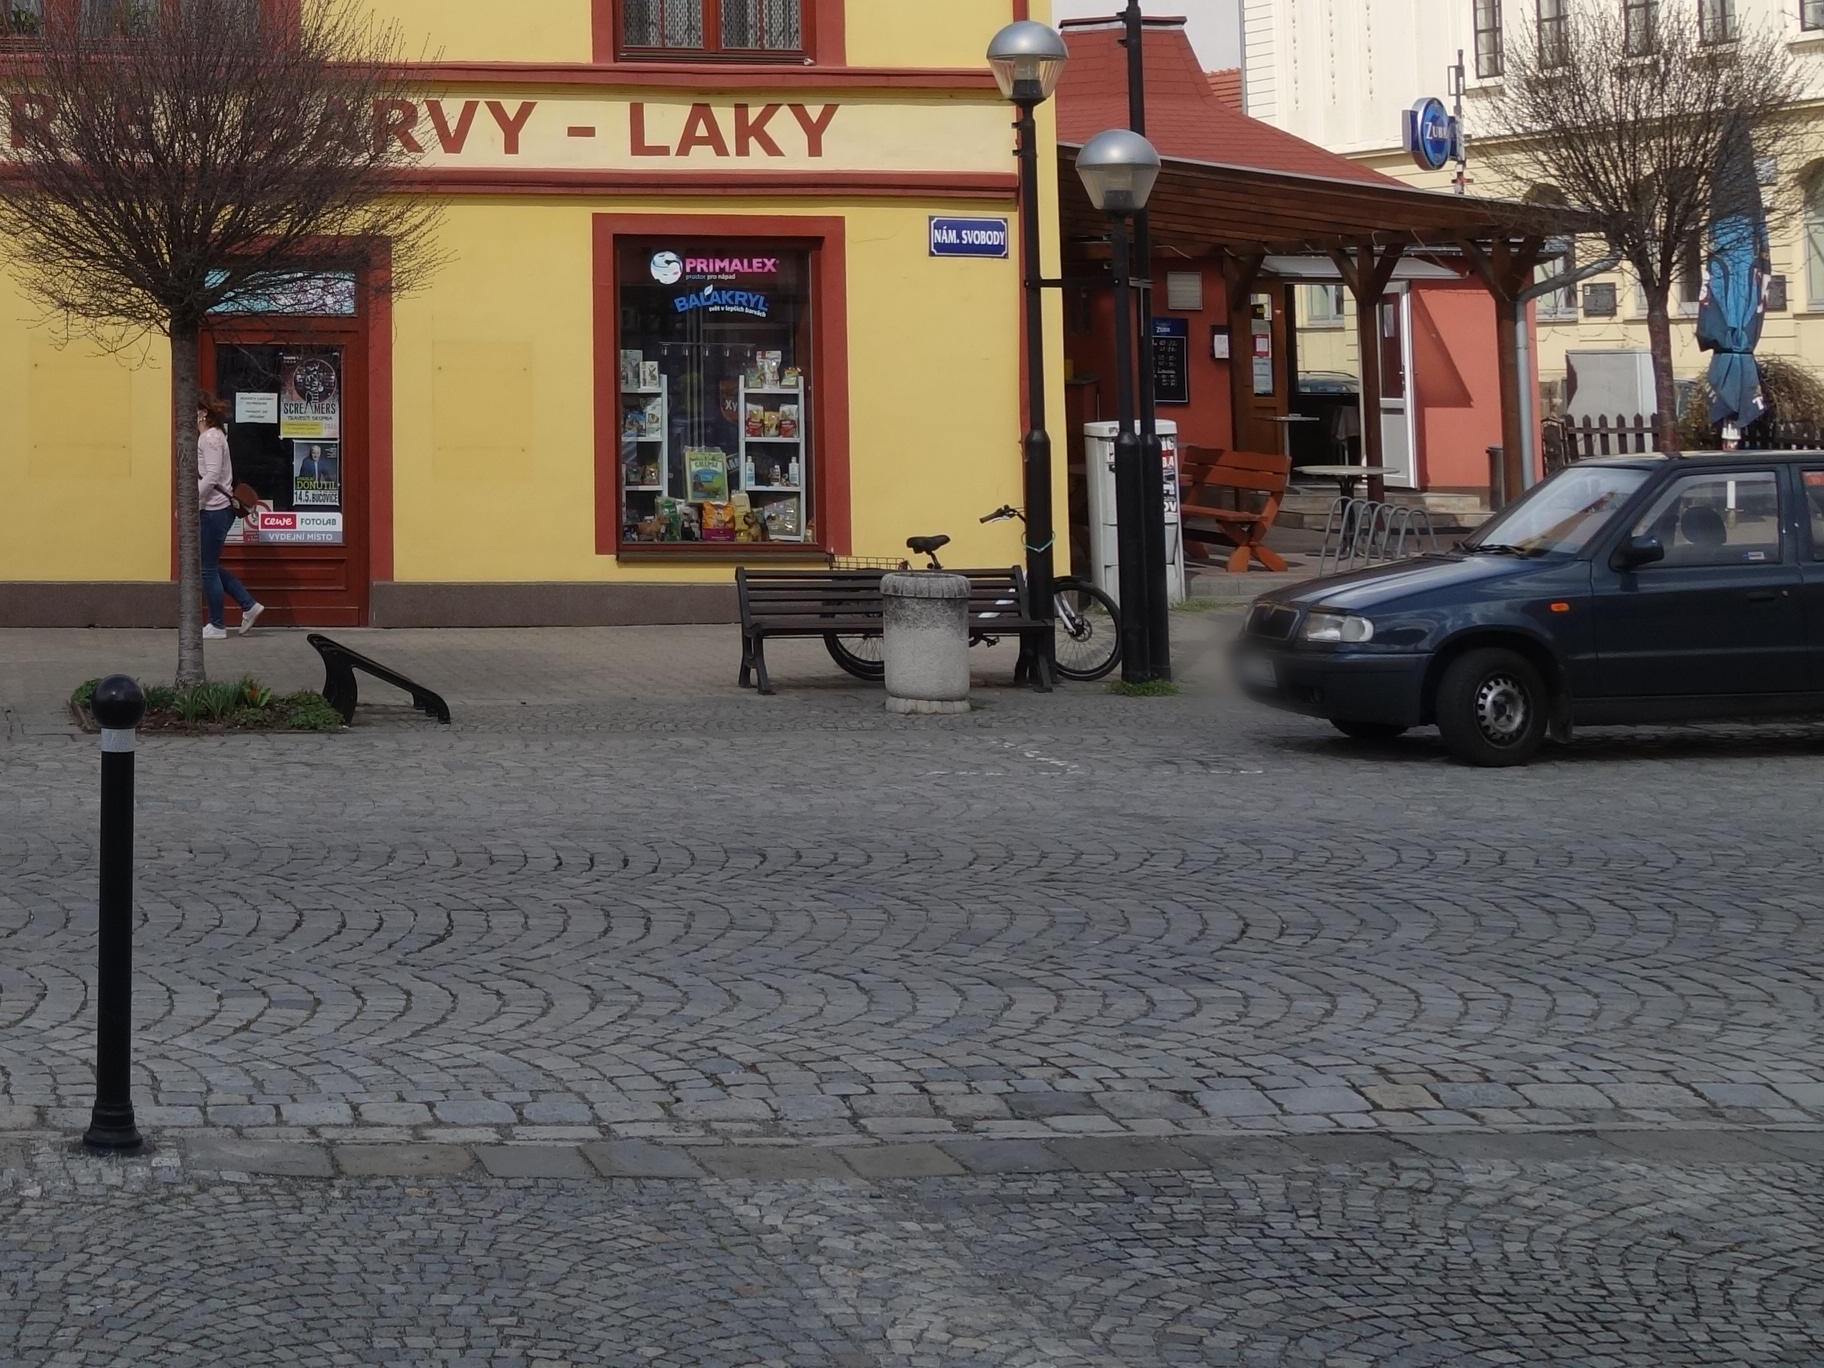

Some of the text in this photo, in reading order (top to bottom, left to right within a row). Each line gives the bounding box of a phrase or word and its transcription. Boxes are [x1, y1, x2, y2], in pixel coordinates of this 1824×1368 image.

[629, 102, 841, 158] LAKY
[934, 226, 1005, 246] NÁM. SVOBODY
[685, 258, 777, 273] PRIMALEX
[674, 290, 769, 313] BALAKRYL
[283, 402, 336, 415] SCREAMERS
[297, 480, 337, 490] DONUTIL
[264, 517, 337, 526] cewe FOTOLAB
